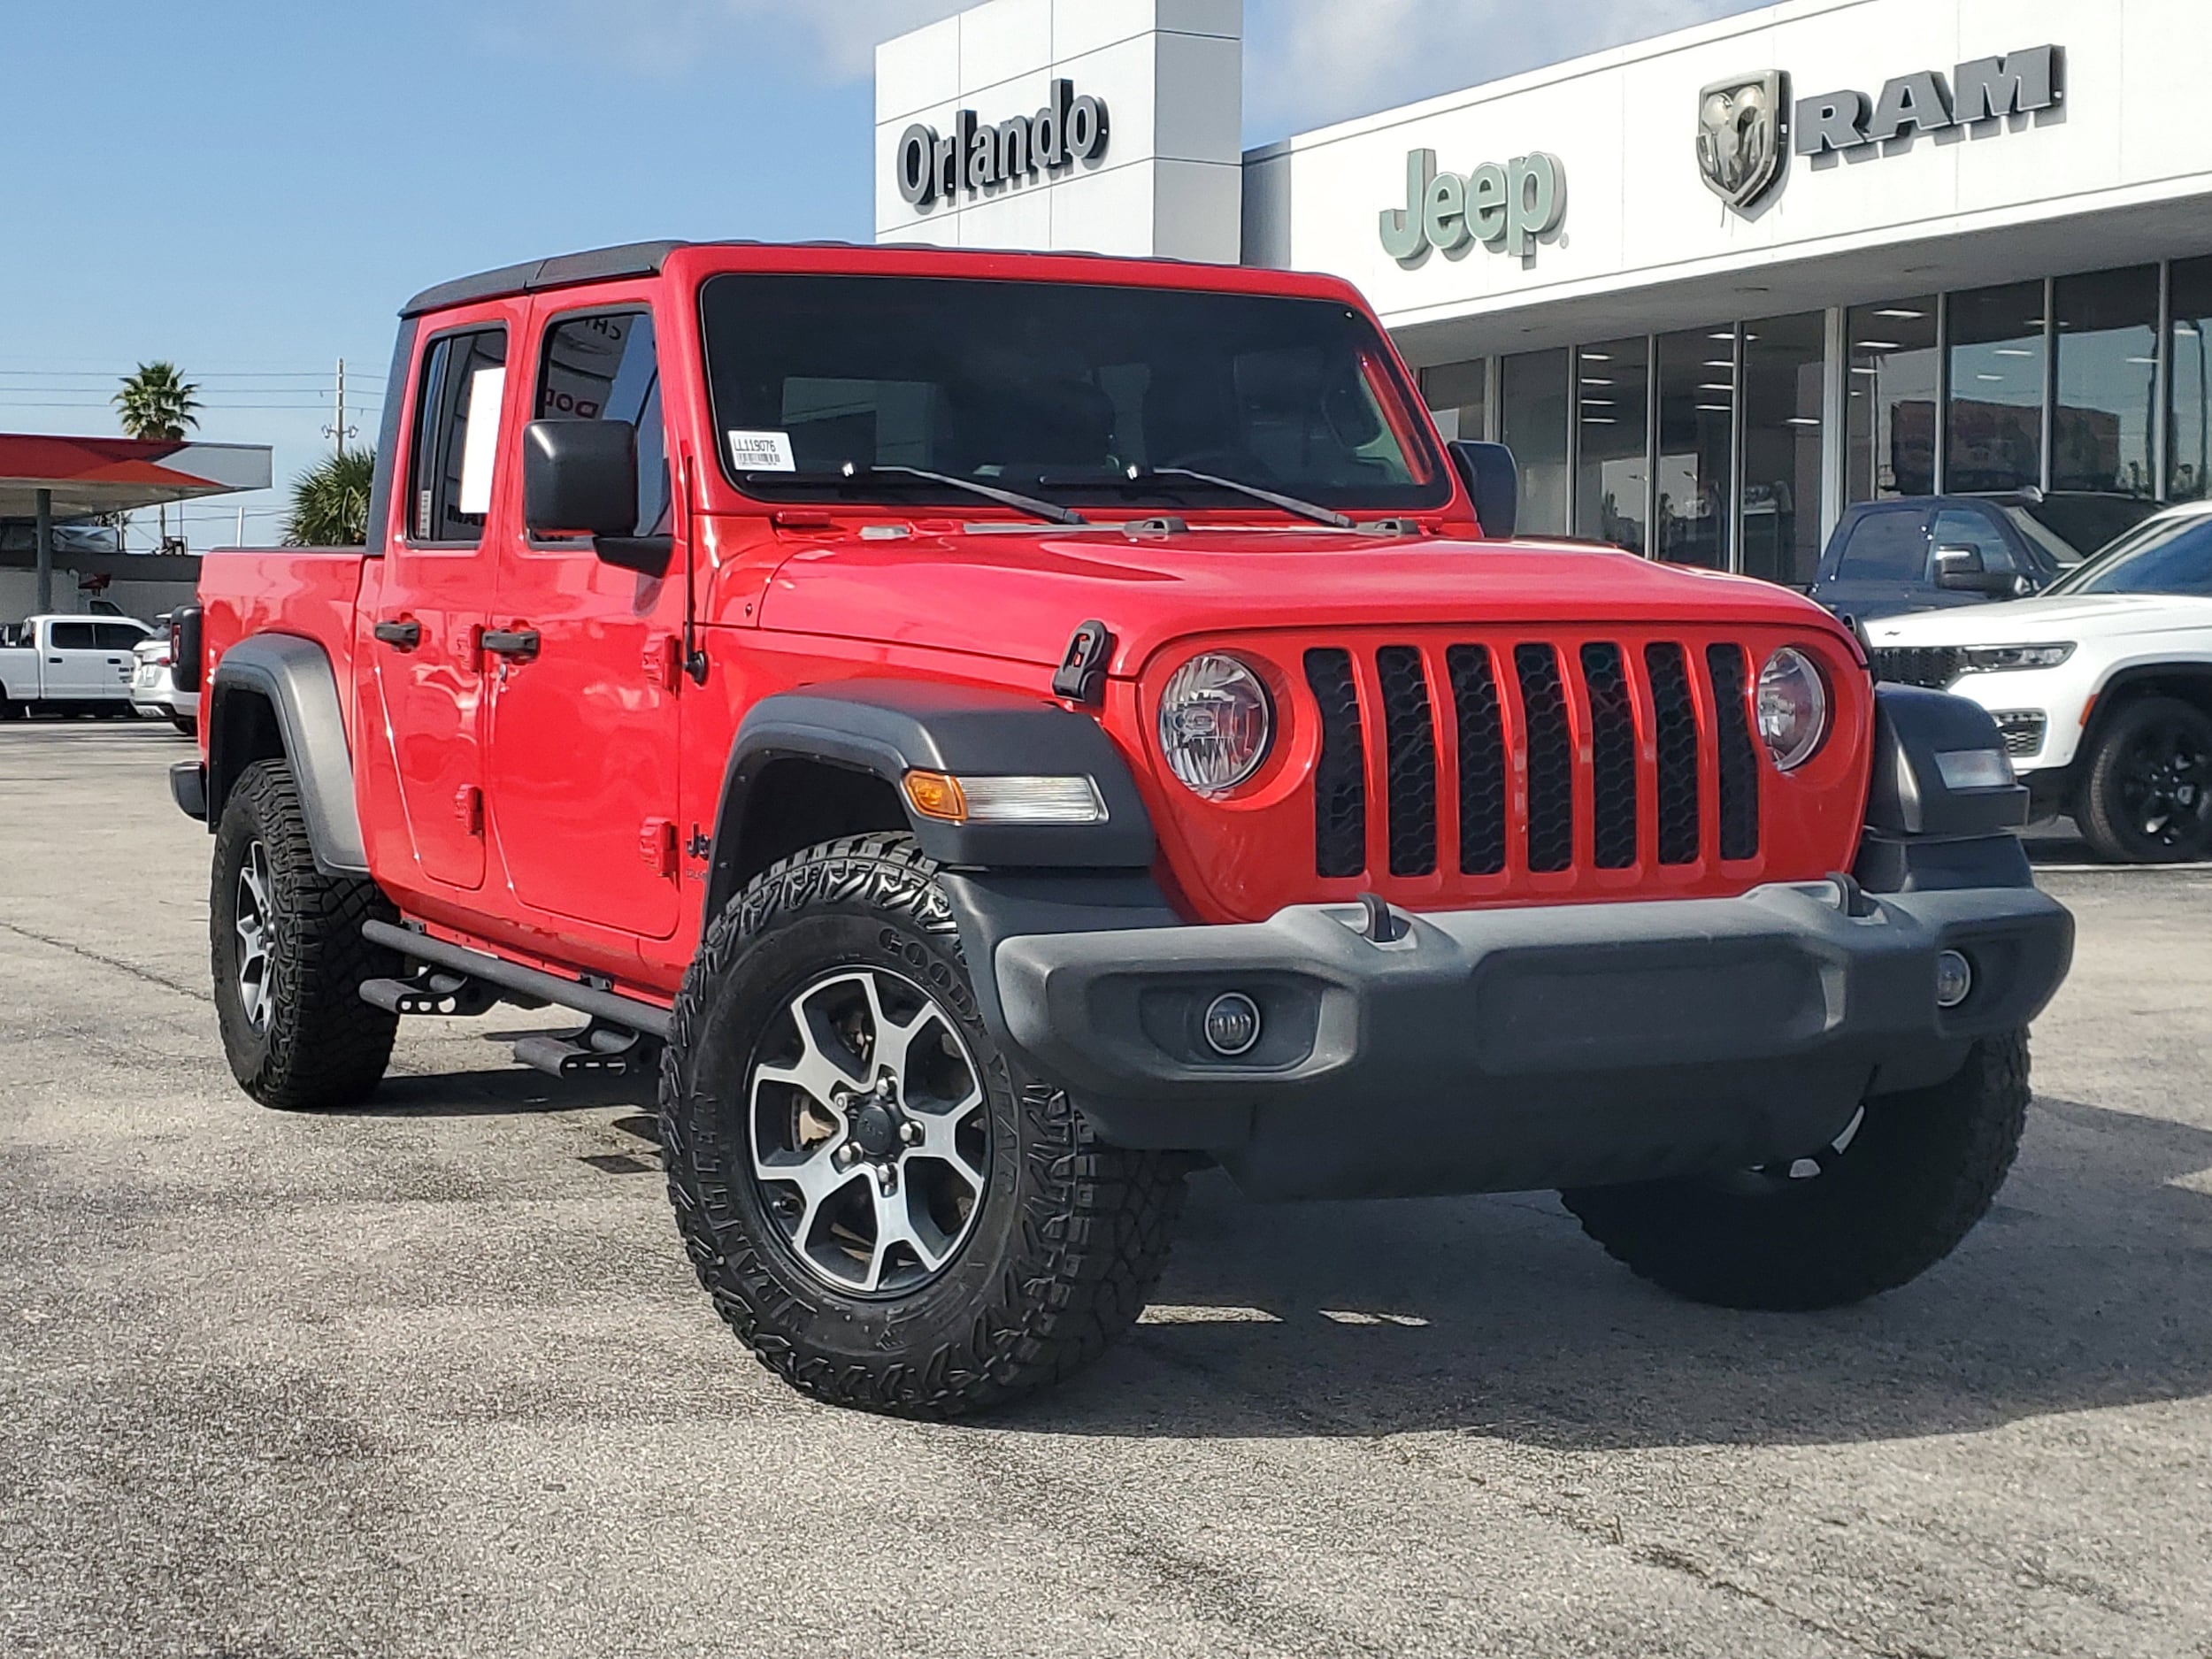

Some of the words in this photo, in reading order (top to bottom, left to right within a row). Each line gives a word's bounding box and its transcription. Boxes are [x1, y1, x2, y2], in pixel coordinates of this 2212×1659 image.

[897, 79, 1109, 207] Orlando
[1795, 44, 2065, 157] RAM
[1379, 148, 1564, 258] Jeep
[733, 438, 776, 452] LL119076
